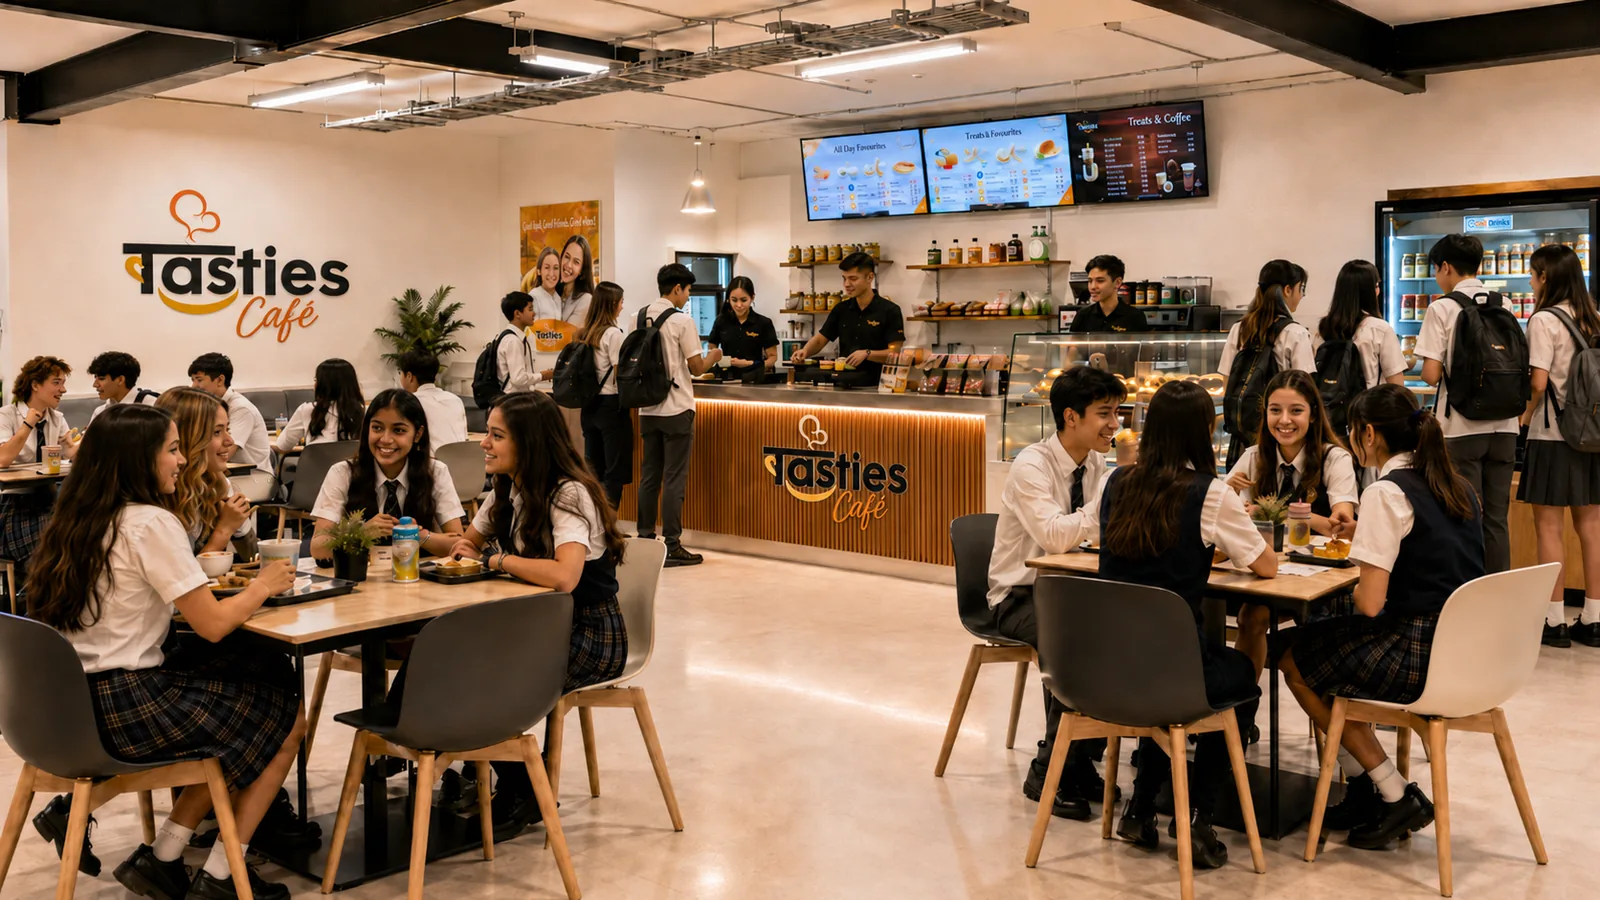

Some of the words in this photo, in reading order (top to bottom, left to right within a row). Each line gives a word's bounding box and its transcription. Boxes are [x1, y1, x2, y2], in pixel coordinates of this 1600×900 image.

[1128, 117, 1152, 126] Treats
[1154, 114, 1162, 124] &
[1164, 112, 1191, 125] Coffee
[122, 242, 350, 297] Tasties
[236, 295, 319, 343] Café
[763, 446, 908, 494] Tasties
[833, 490, 889, 531] Café
